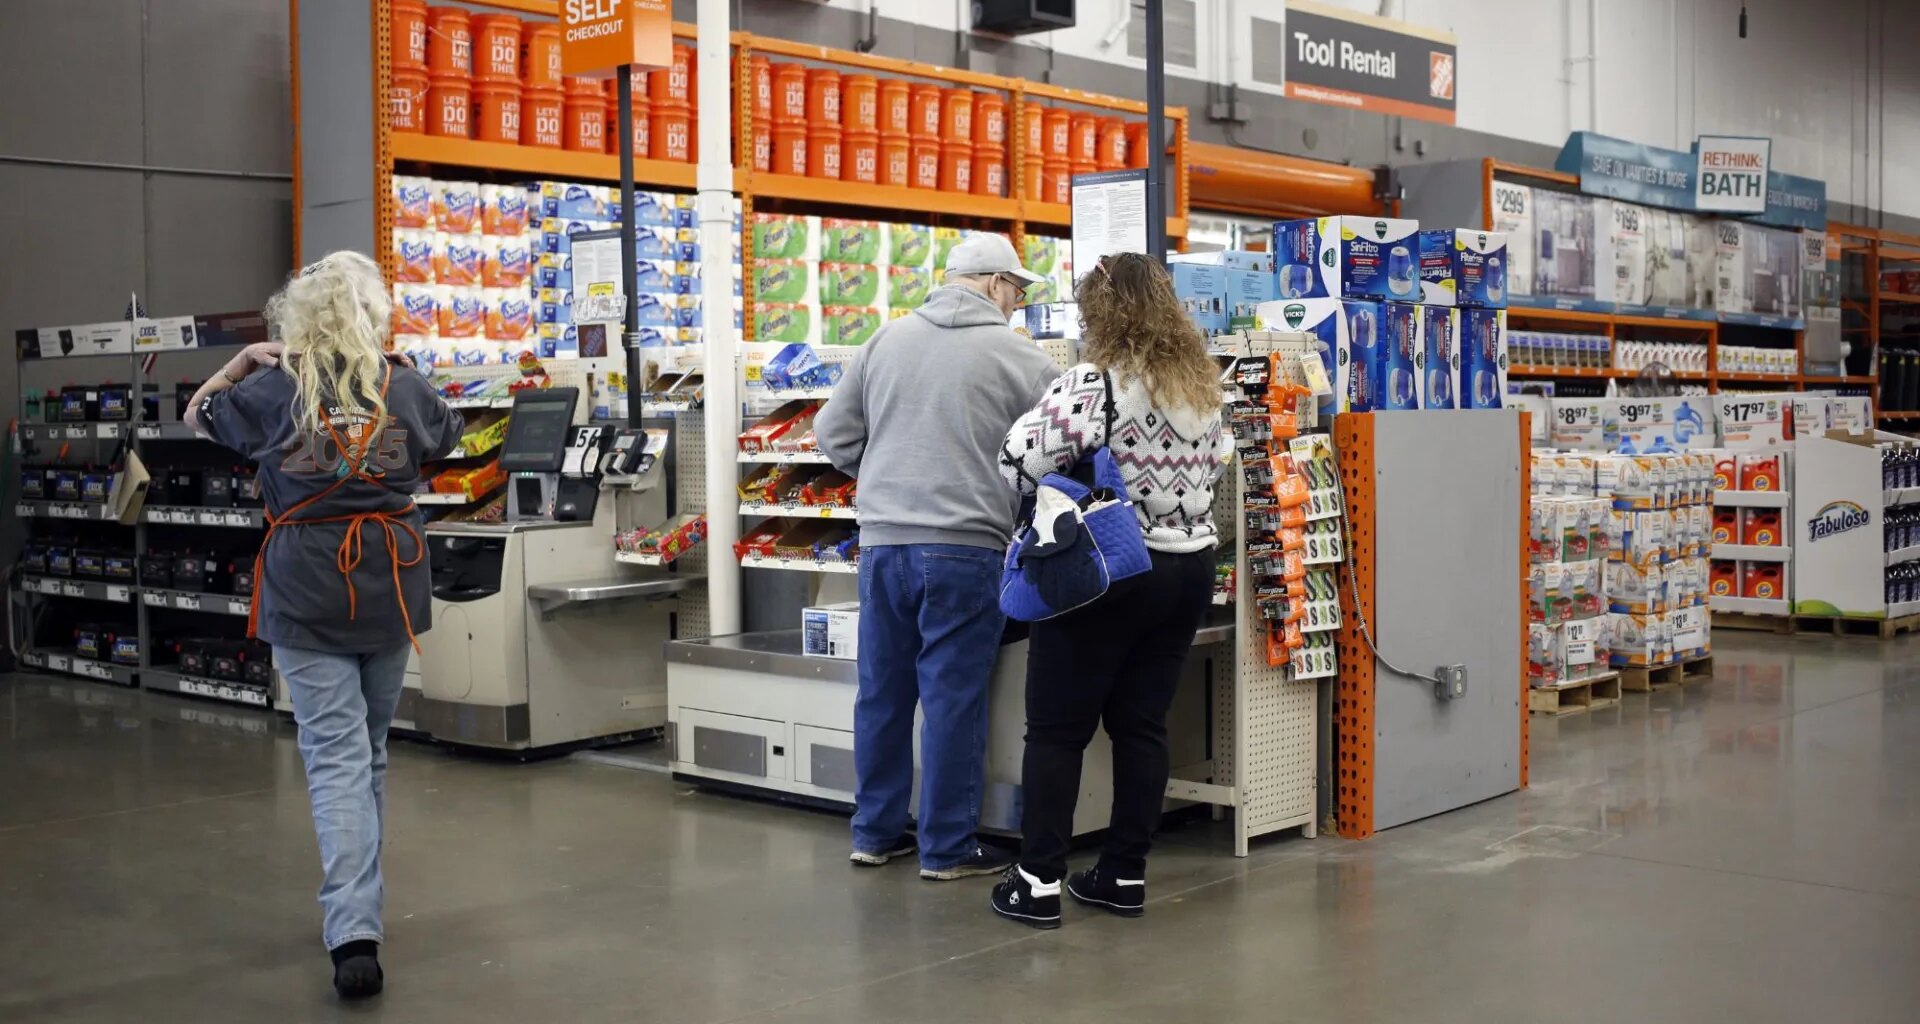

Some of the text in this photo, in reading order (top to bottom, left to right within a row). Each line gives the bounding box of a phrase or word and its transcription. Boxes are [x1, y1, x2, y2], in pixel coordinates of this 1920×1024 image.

[566, 19, 623, 42] CHECKOUT
[491, 45, 515, 63] DO
[1294, 31, 1335, 67] Tool
[1340, 41, 1396, 78] Rental
[669, 73, 688, 88] DO
[443, 105, 467, 123] DO
[536, 116, 559, 134] DO
[580, 121, 601, 138] DO
[668, 132, 687, 149] DO
[856, 158, 876, 172] DO
[1703, 152, 1763, 168] RETHINK:
[1592, 156, 1688, 189] SAVE ON VANITIES & MORE
[1701, 172, 1762, 197] BATH
[1496, 188, 1524, 214] $299
[1616, 208, 1639, 231] $199
[1351, 241, 1379, 252] SinFiltro
[139, 326, 157, 336] EXIDE
[1238, 362, 1266, 371] Energizer
[577, 429, 600, 448] 56
[280, 428, 409, 472] 205
[1244, 452, 1267, 460] Energizer
[1808, 509, 1870, 540] Fabuloso
[1248, 543, 1273, 551] Energizer
[1258, 587, 1285, 595] Energizer
